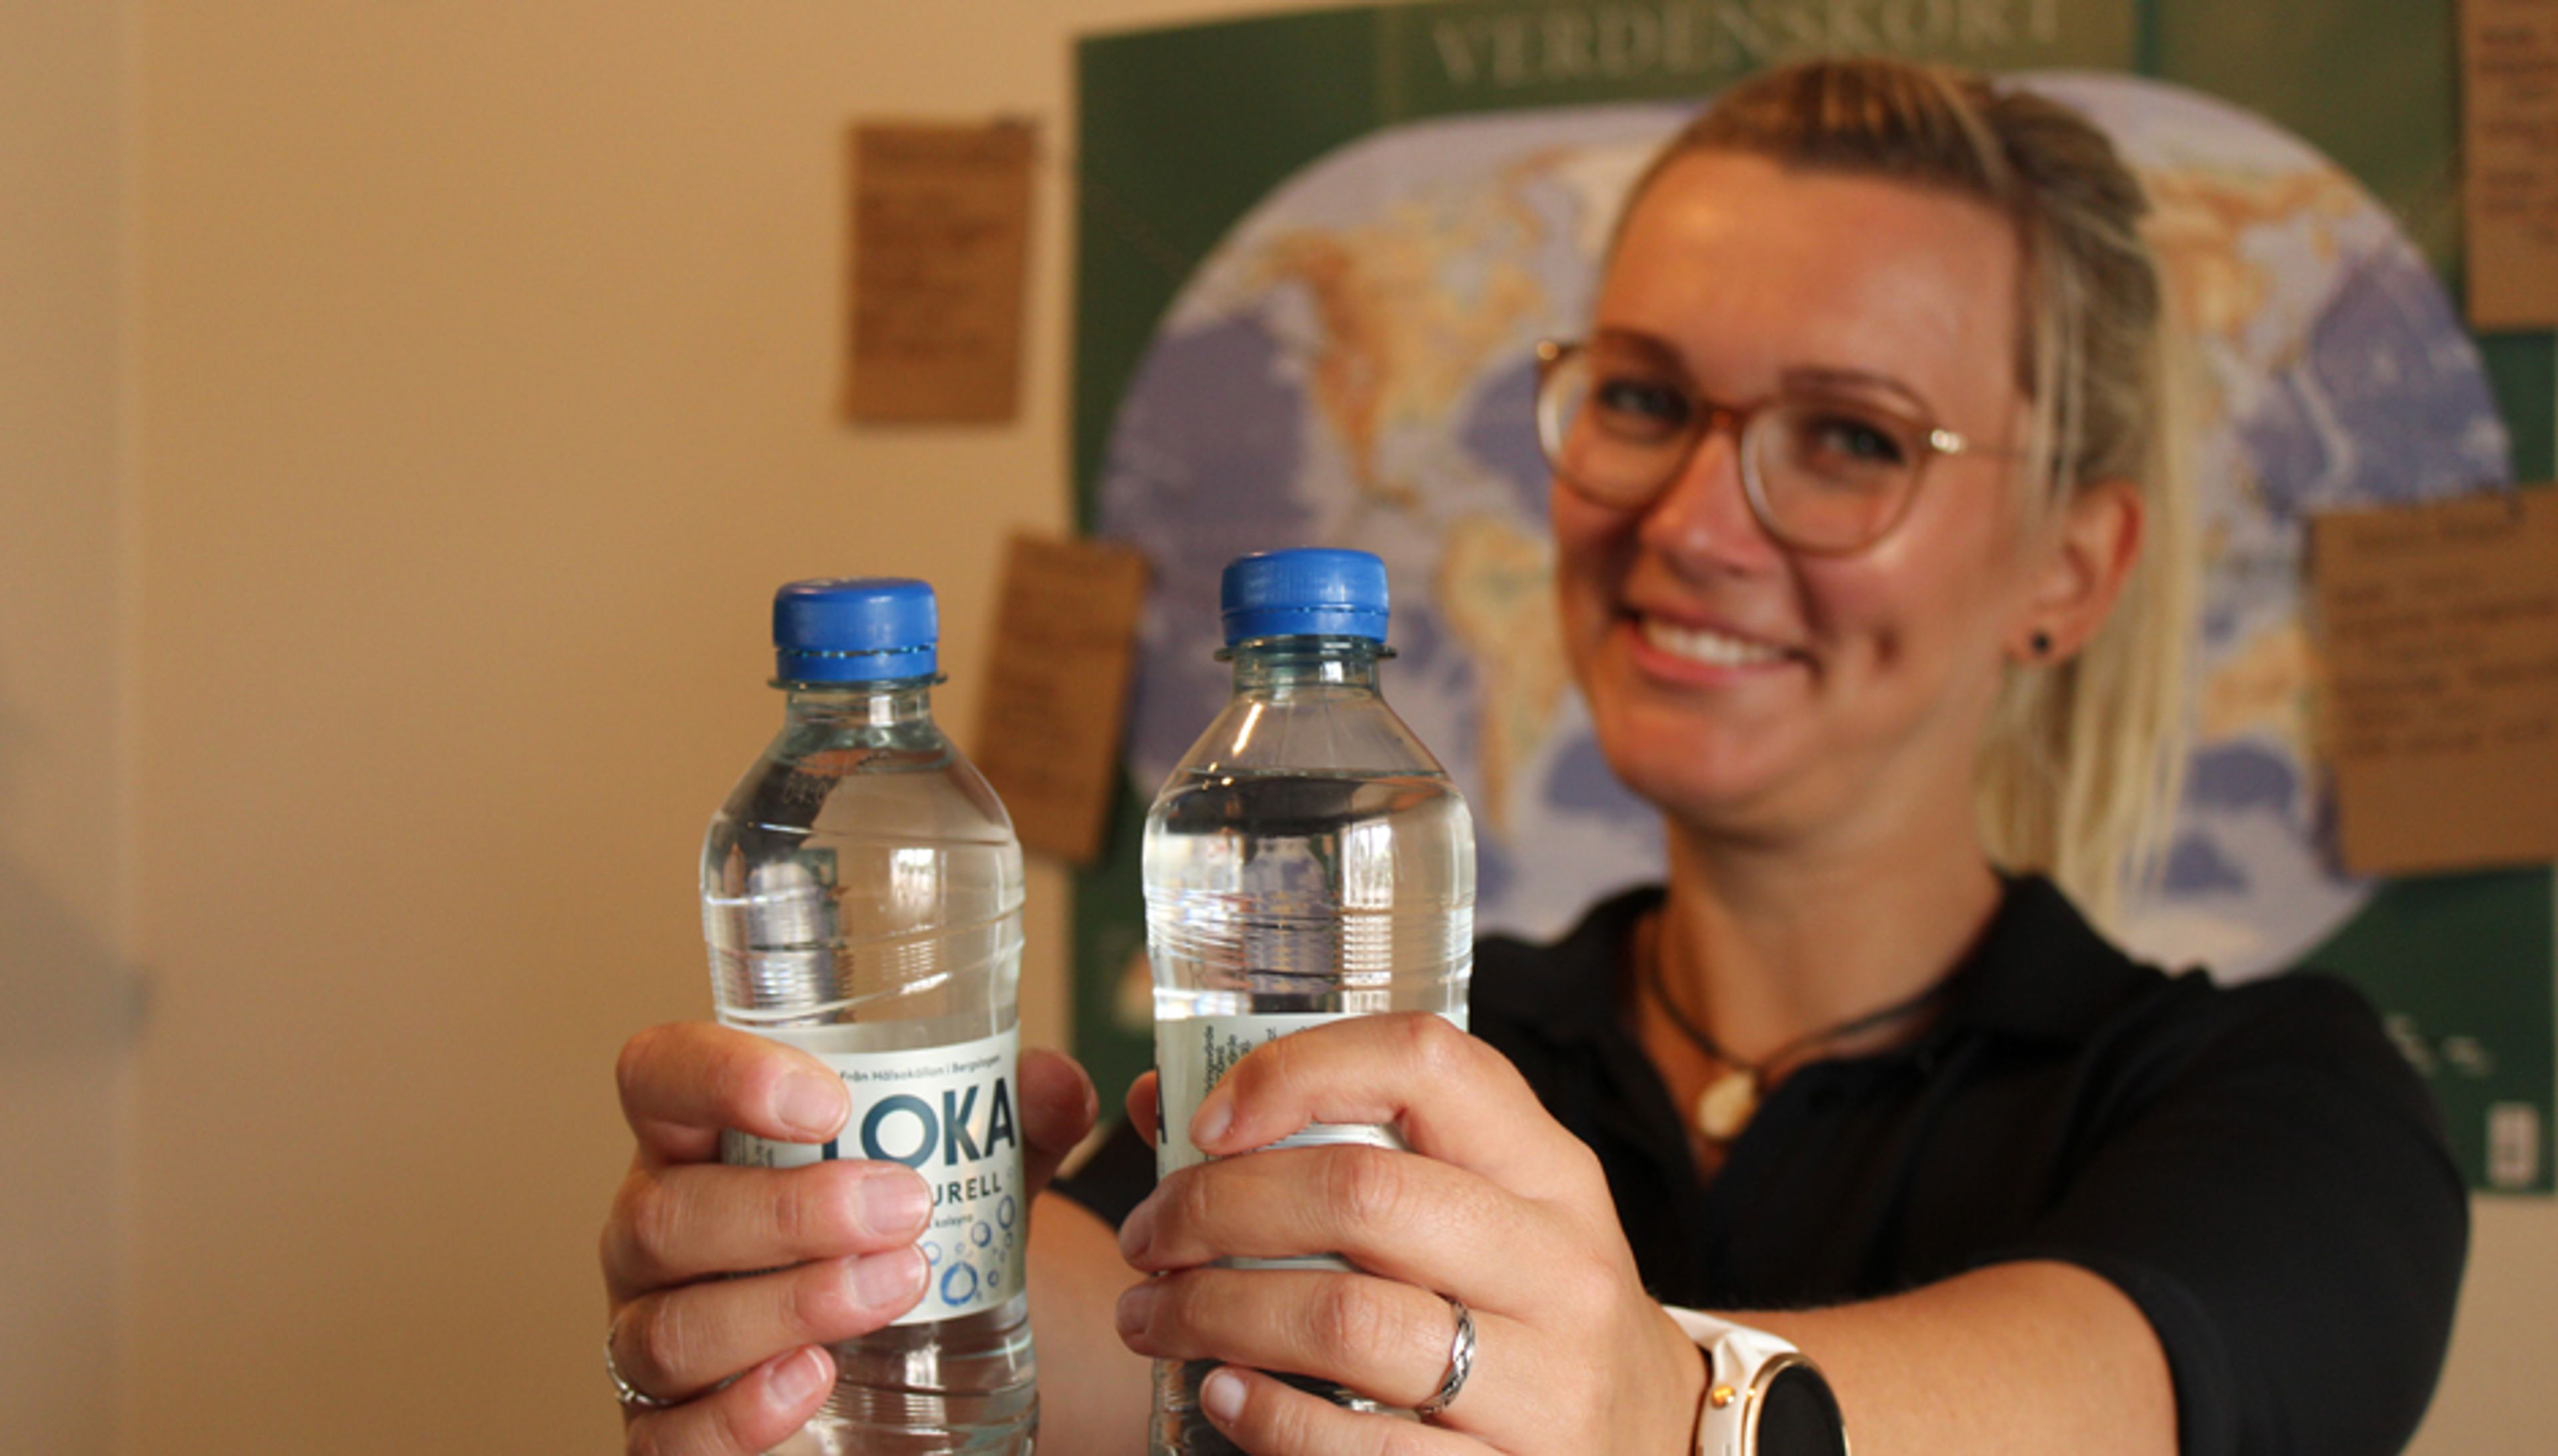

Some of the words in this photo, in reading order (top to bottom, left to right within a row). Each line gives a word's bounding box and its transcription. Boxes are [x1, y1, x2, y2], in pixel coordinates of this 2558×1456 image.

[1431, 0, 2064, 88] VERDENSKORT
[840, 1068, 869, 1083] Från
[933, 1173, 1002, 1206] URELL
